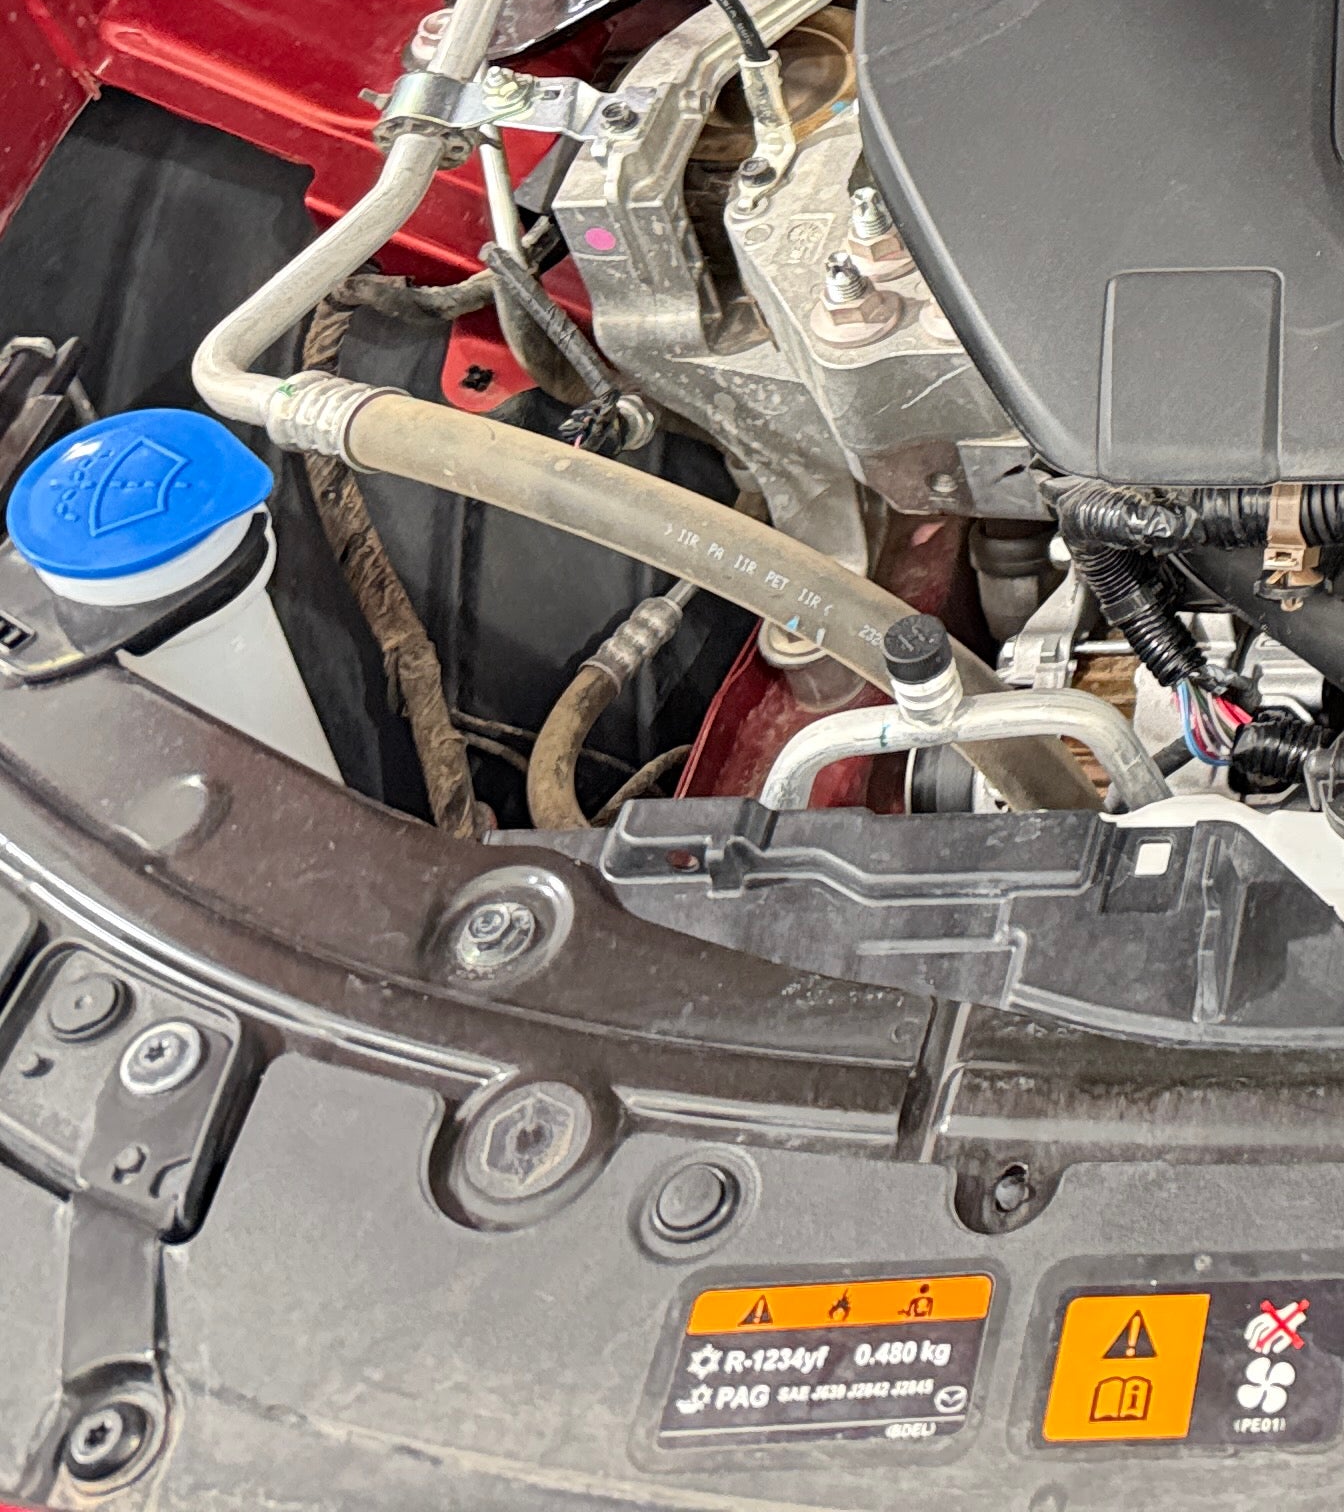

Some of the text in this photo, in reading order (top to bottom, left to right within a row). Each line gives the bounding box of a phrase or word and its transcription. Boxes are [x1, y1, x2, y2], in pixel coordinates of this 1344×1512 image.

[706, 541, 725, 562] PA
[733, 554, 758, 577] IIR
[764, 570, 791, 592] PET
[722, 1339, 953, 1375] R-1234yf 0.480 kg
[713, 1383, 771, 1411] PAG
[776, 1385, 811, 1404] SAE
[1233, 1417, 1287, 1434] (PE01)
